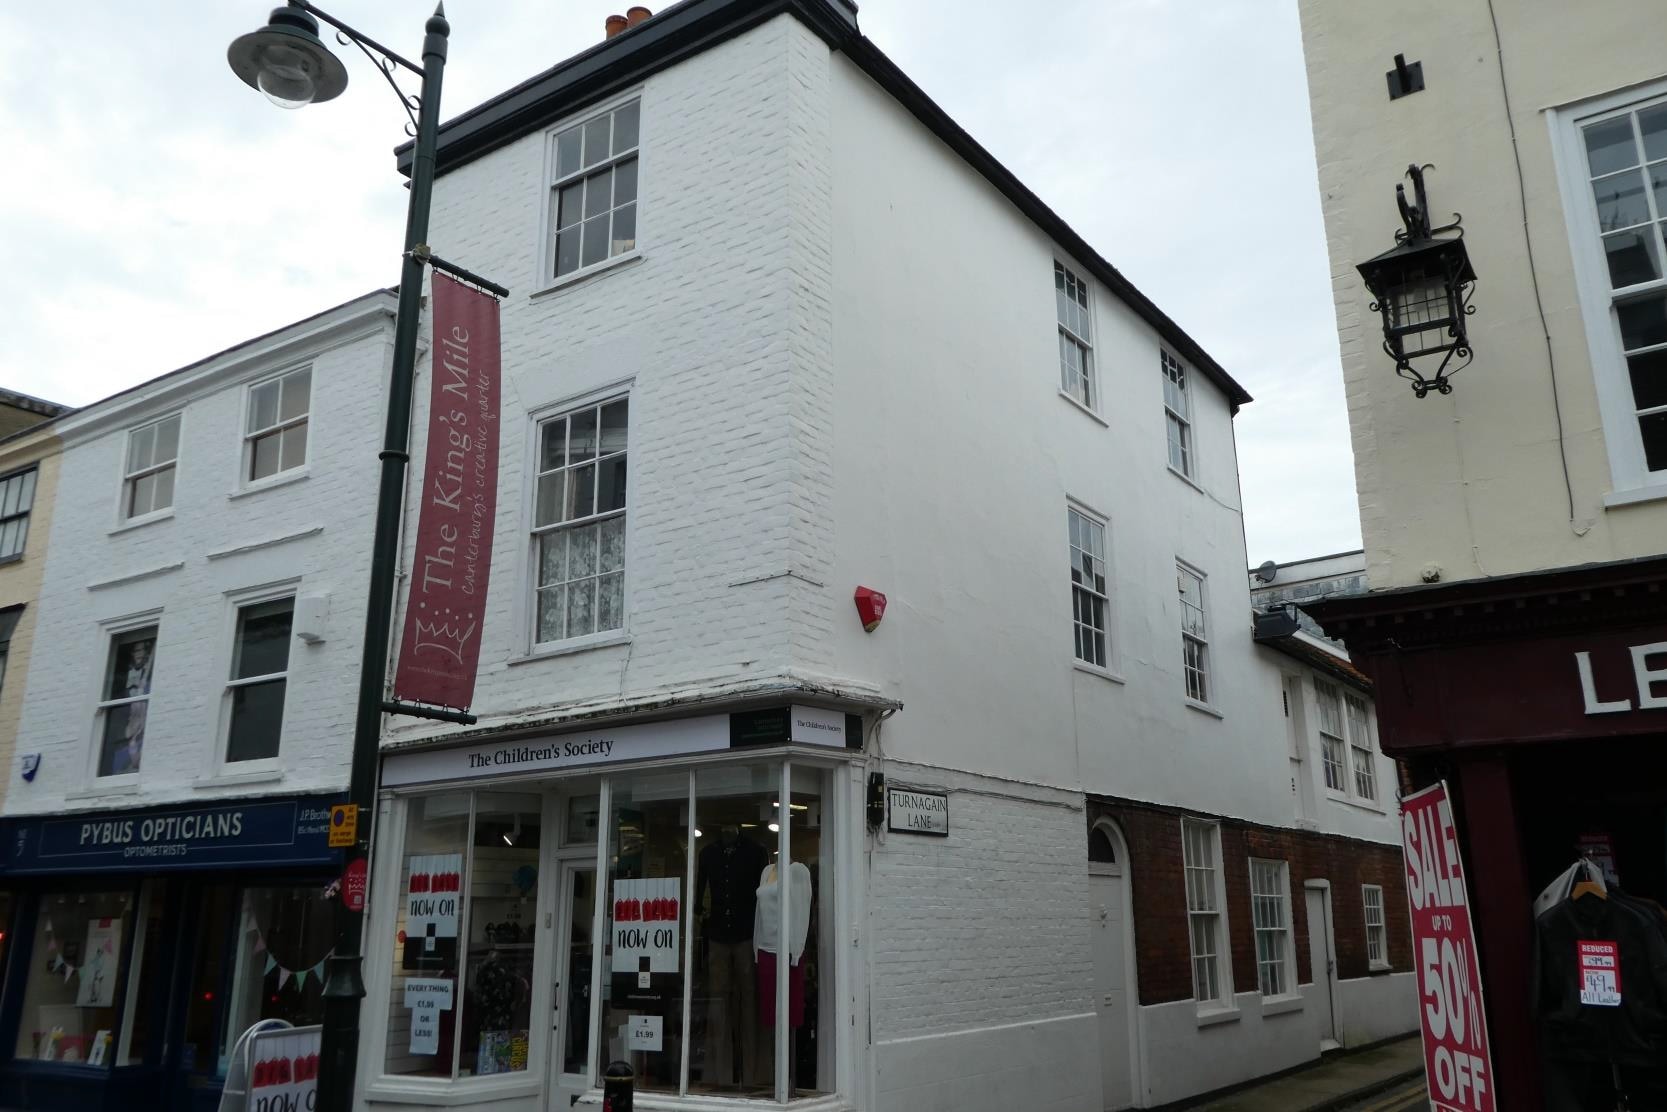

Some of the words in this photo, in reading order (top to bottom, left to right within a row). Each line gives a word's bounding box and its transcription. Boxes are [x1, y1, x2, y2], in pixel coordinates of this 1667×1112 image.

[442, 325, 470, 401] Mile
[475, 369, 497, 422] quarter
[432, 410, 472, 513] King's
[472, 424, 488, 487] creative
[423, 523, 458, 594] The
[1574, 641, 1667, 715] LE
[468, 753, 491, 768] The
[494, 743, 560, 765] Children's
[564, 739, 614, 757] Society
[79, 821, 133, 845] PYBUS
[141, 812, 243, 841] OPTICIANS
[891, 793, 946, 812] TURNAGAIN
[907, 813, 932, 828] LANE
[124, 844, 187, 857] OPTOMETRISTS
[1404, 799, 1466, 910] SALE
[1431, 915, 1441, 931] UP
[1441, 914, 1452, 931] TO
[1582, 944, 1614, 953] REDUCED
[1421, 937, 1482, 1050] 50%
[635, 1030, 654, 1039] £1.99
[1434, 1045, 1487, 1111] OFF
